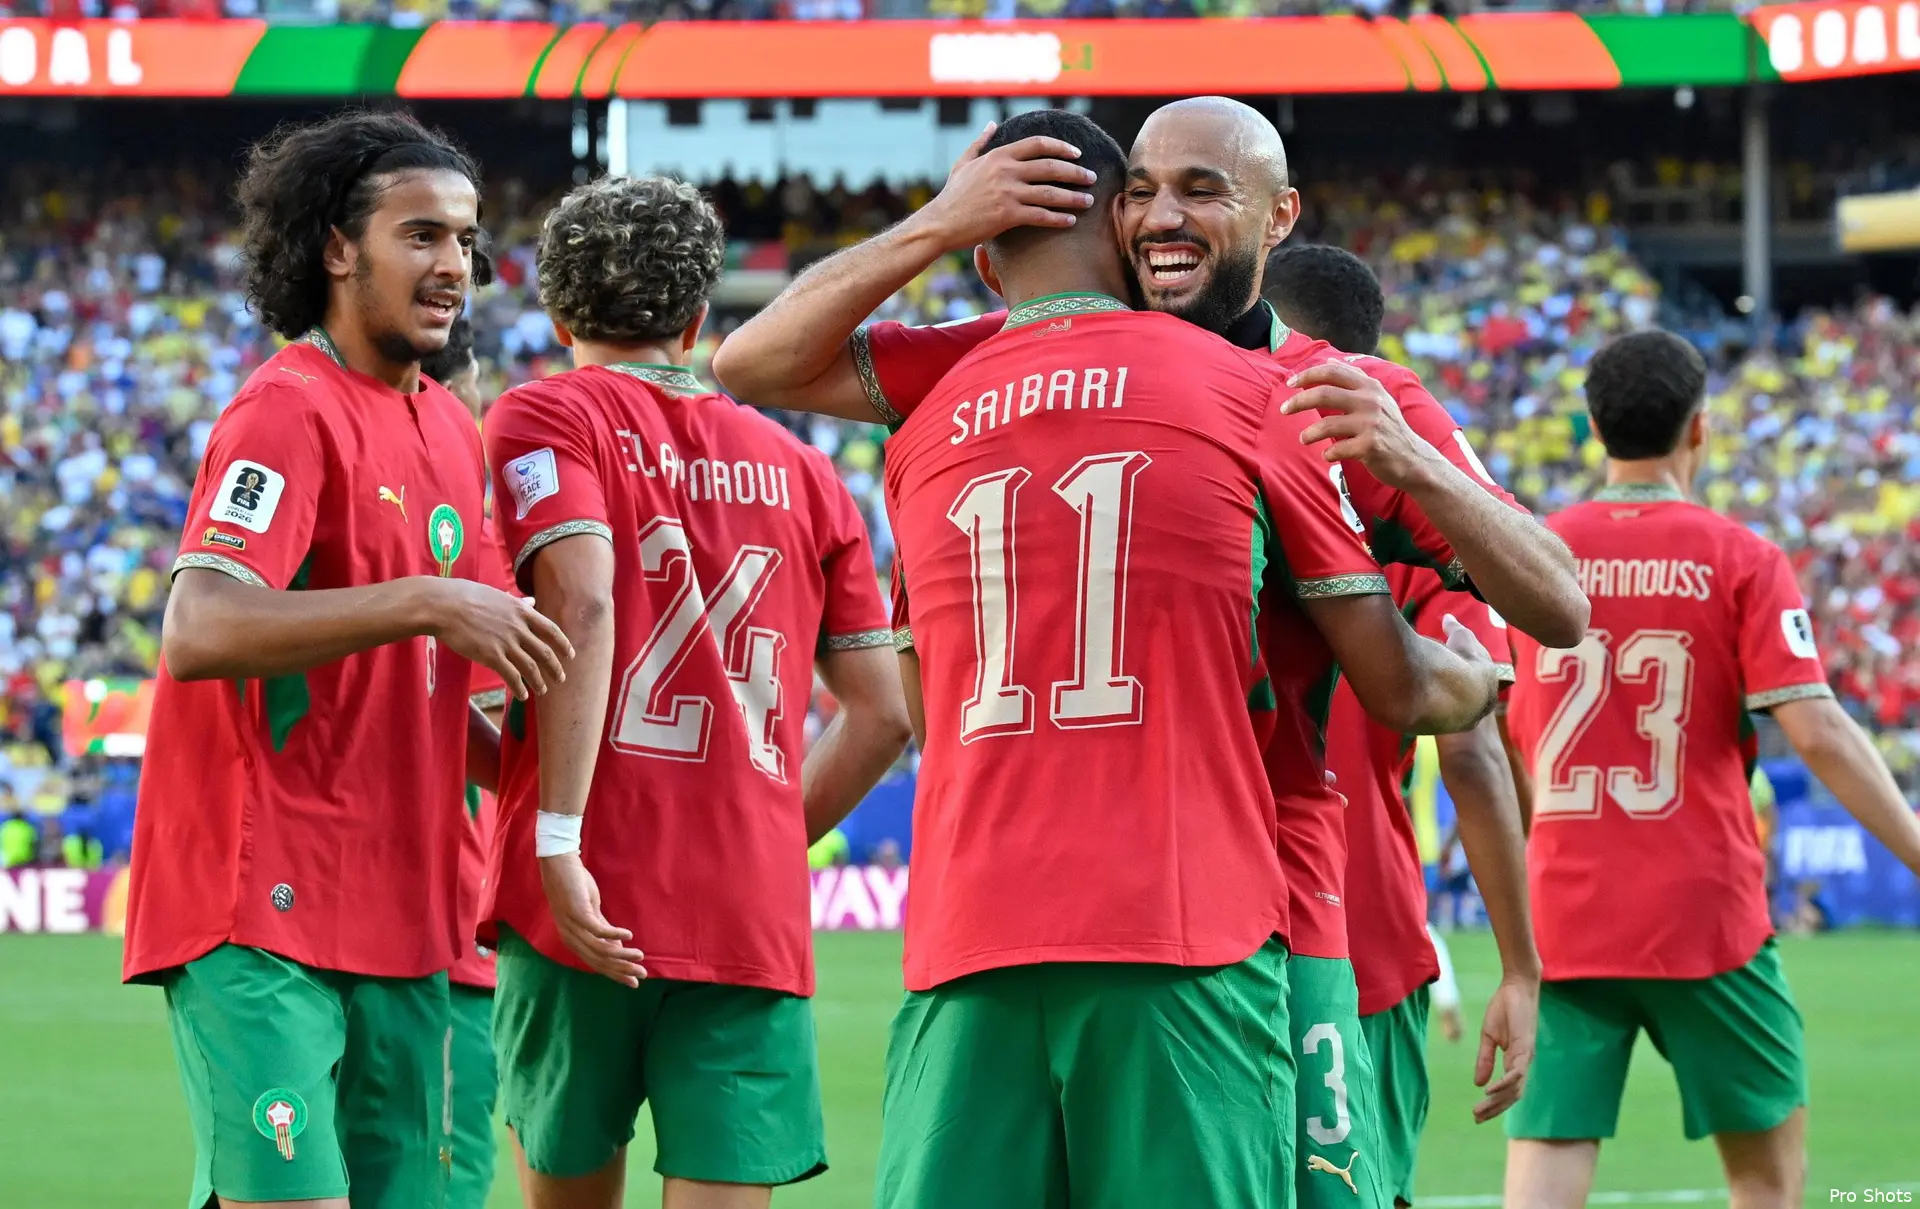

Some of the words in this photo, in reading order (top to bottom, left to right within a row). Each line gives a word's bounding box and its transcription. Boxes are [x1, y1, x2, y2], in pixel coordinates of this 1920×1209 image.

[951, 367, 1128, 445] SAIBARI
[224, 509, 252, 523] 2026
[609, 515, 787, 784] 24
[946, 451, 1153, 746] 11
[1534, 629, 1694, 820] 23
[1302, 1023, 1350, 1146] 3
